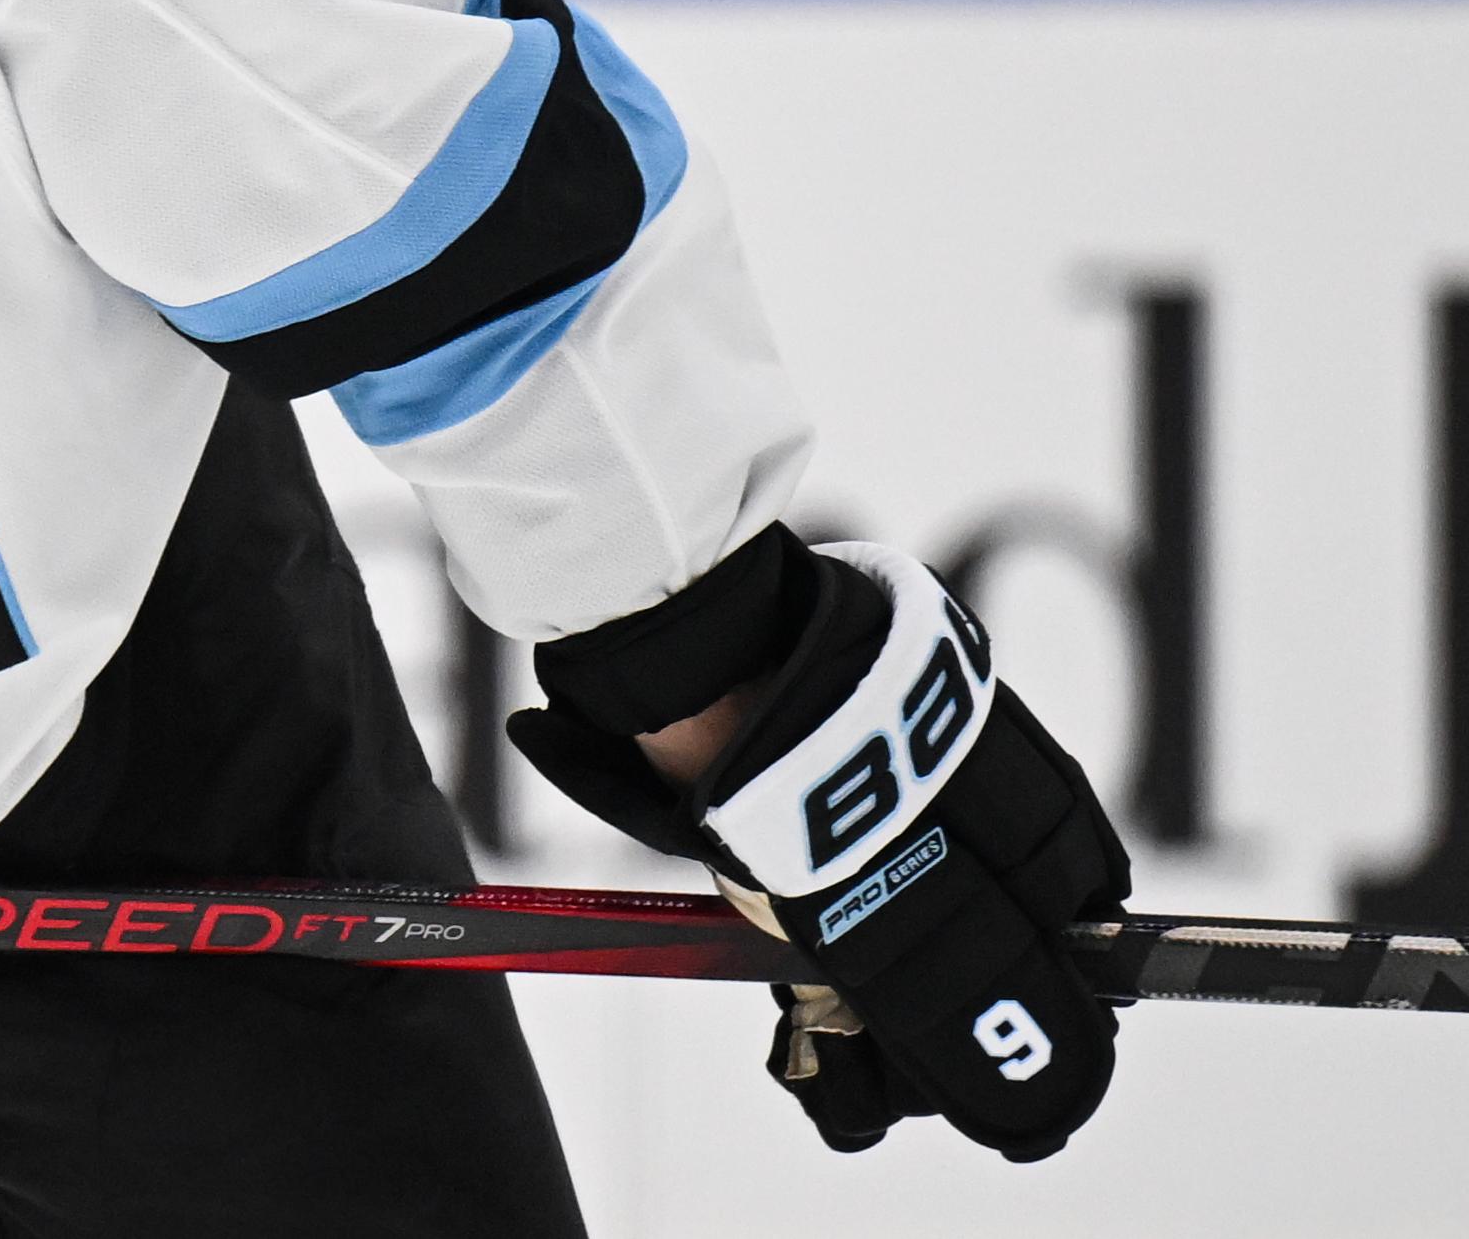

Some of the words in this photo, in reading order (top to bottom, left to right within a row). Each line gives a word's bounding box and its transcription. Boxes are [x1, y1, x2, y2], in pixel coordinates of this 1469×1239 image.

[825, 881, 882, 934] PRO
[889, 840, 941, 883] SERIES
[972, 999, 1053, 1081] 9
